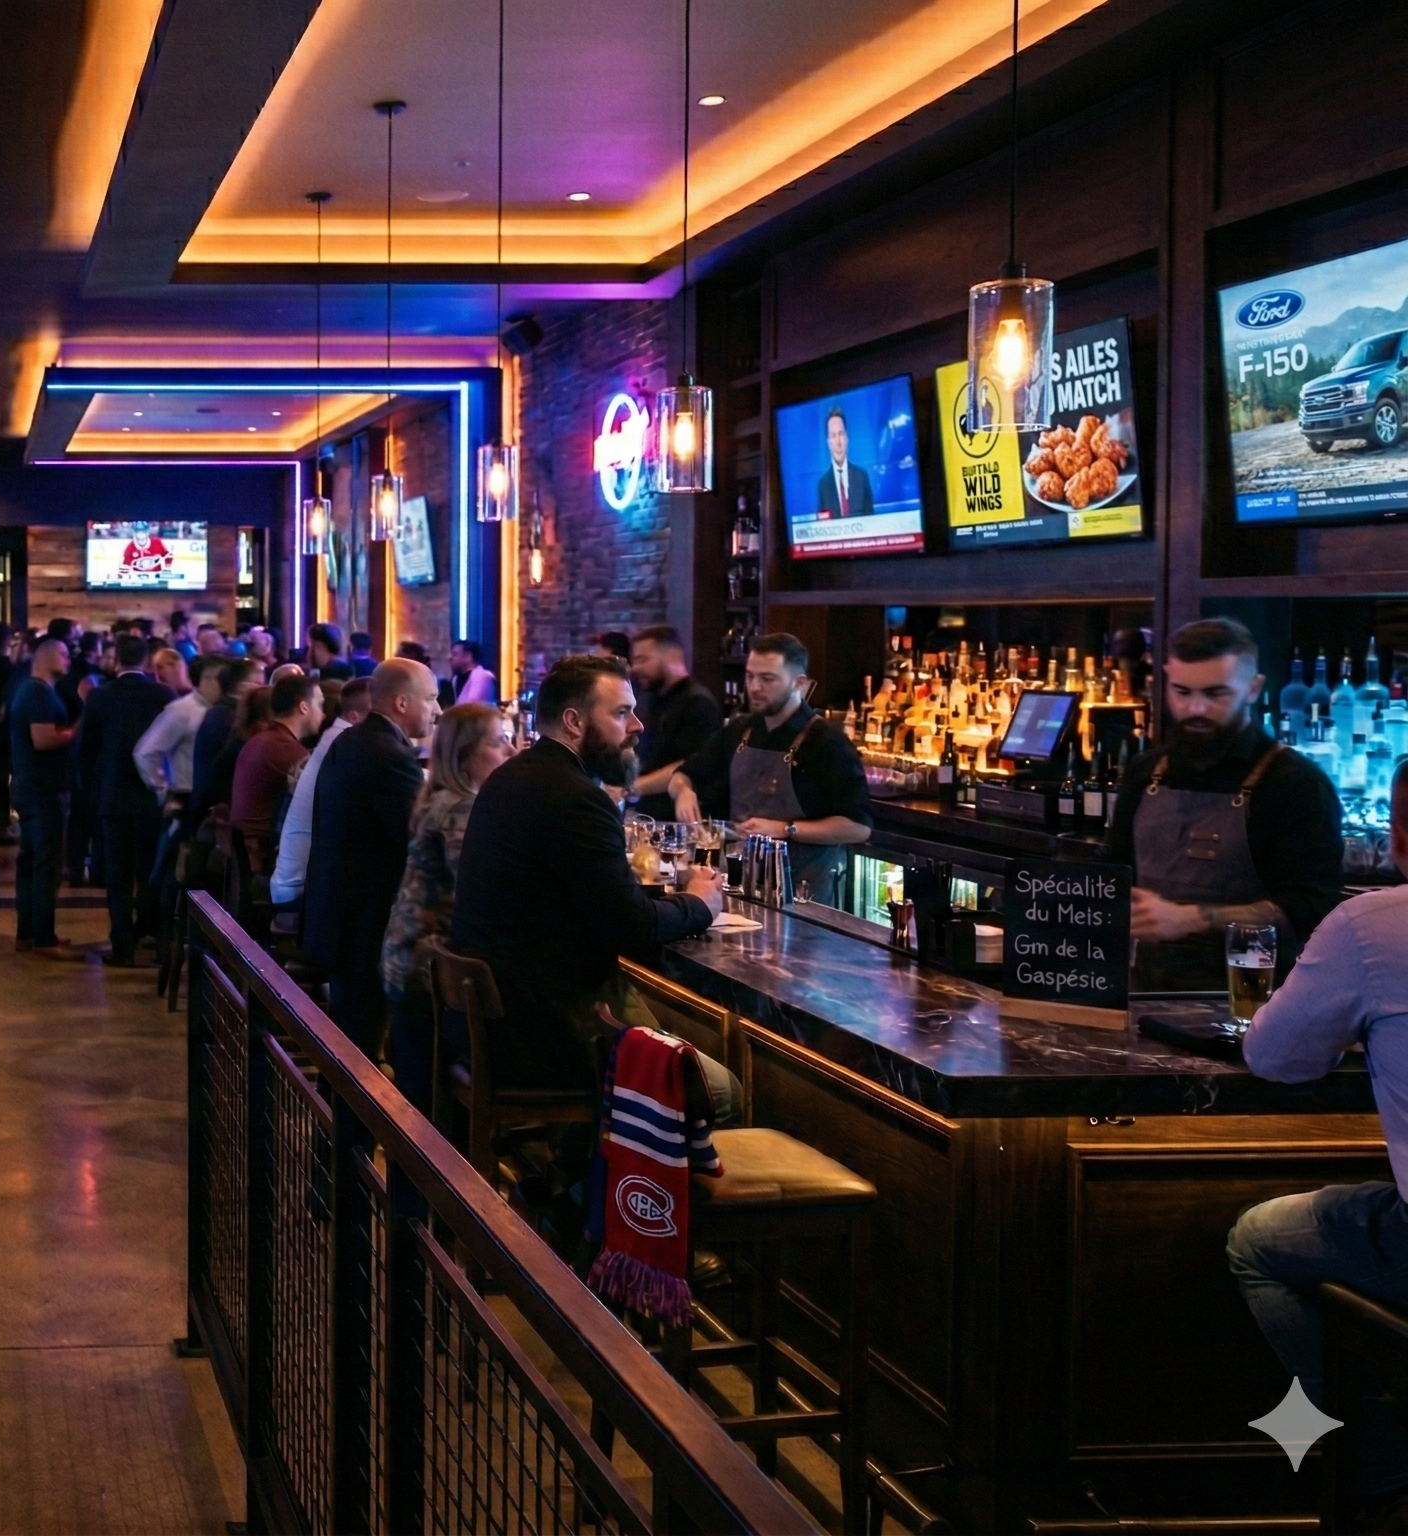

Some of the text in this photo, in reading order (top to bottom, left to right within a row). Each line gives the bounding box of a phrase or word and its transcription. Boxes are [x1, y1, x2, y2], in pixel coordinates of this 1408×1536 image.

[1248, 295, 1291, 325] Ford
[1065, 337, 1119, 379] AILES
[1239, 343, 1308, 383] F-150
[1056, 370, 1122, 413] MATCH
[963, 473, 1001, 497] WILD
[965, 494, 1003, 513] WINGS
[1015, 870, 1116, 899] Spécialité
[1025, 902, 1049, 922] du
[1055, 938, 1078, 958] de
[1087, 939, 1105, 961] la
